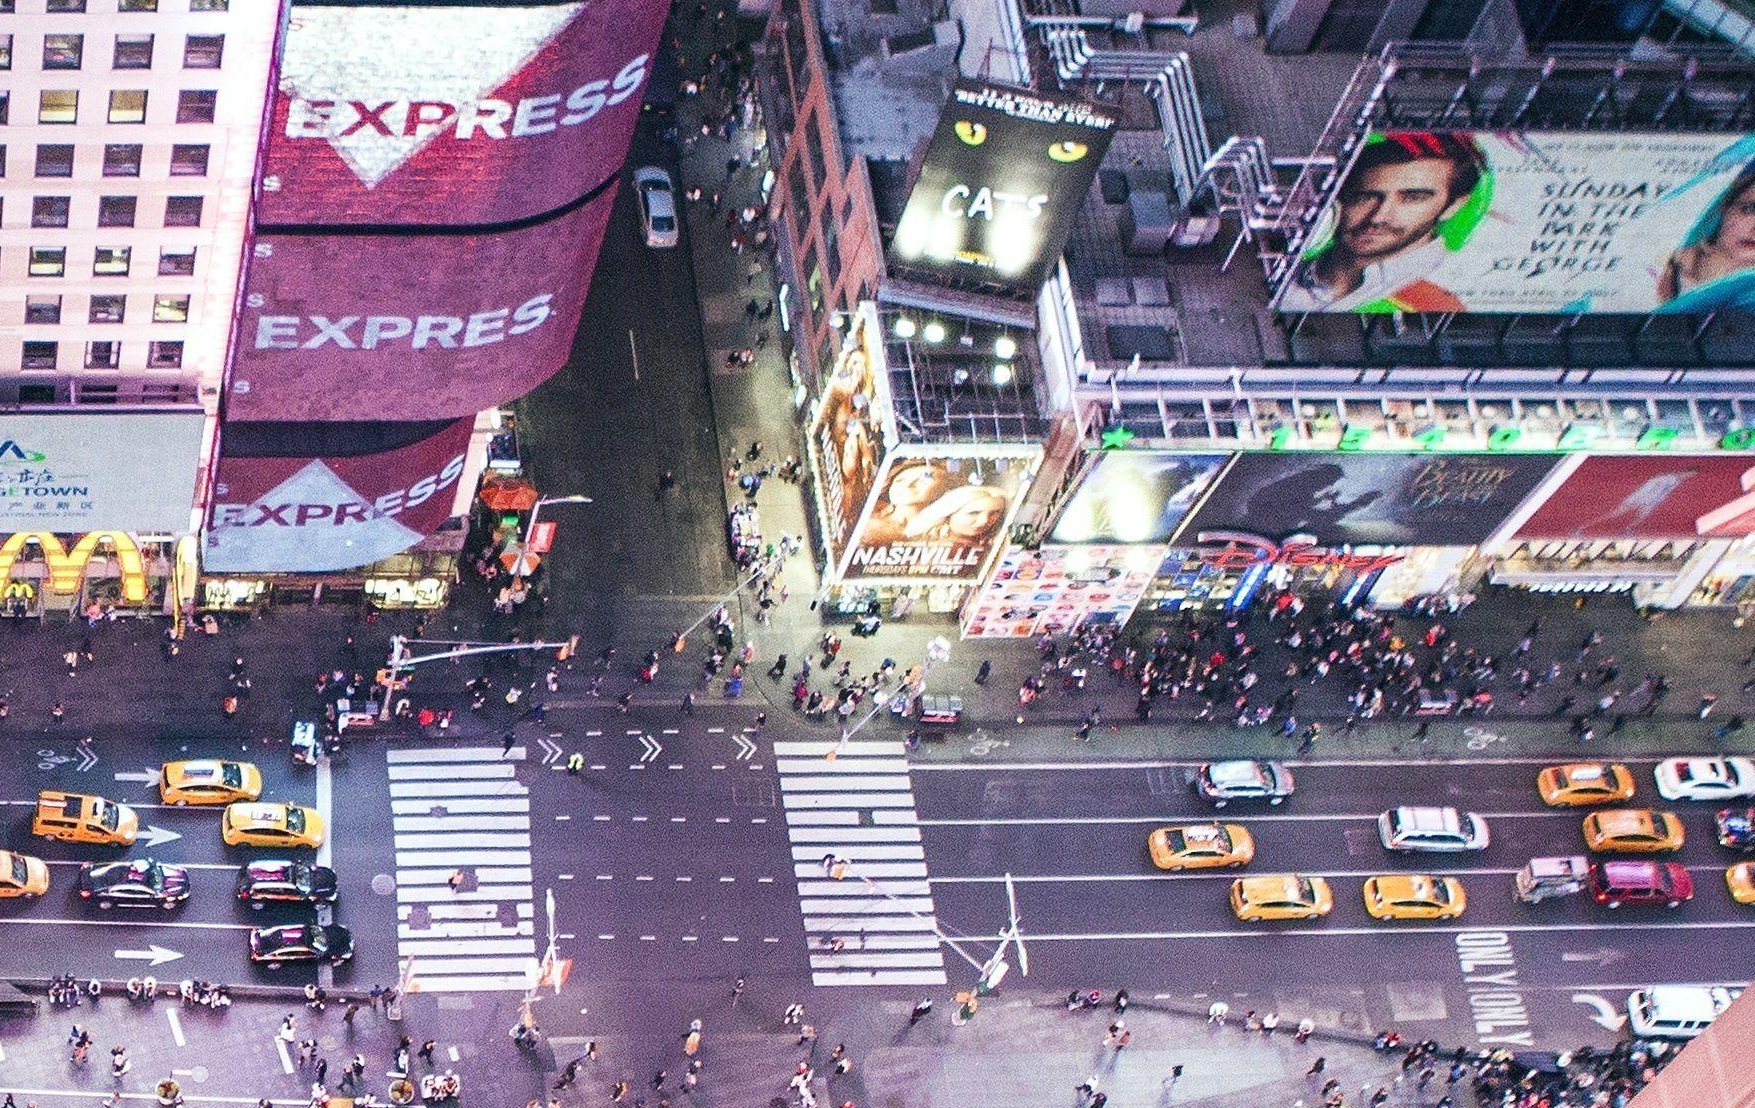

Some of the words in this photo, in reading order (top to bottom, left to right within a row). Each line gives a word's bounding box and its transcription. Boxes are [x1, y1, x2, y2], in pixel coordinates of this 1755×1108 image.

[285, 53, 649, 140] EXPRESS
[942, 184, 1048, 221] CATS
[1543, 181, 1672, 200] SUNDAY
[1539, 203, 1575, 218] IN
[1591, 203, 1644, 219] THE
[1541, 222, 1622, 236] PARK
[1531, 240, 1611, 254] WITH
[254, 294, 558, 350] EXPRES
[213, 454, 465, 528] EXPRESS
[851, 545, 985, 566] NASHVILLE
[1455, 932, 1518, 986] ONLY
[1470, 992, 1535, 1047] ONLY
